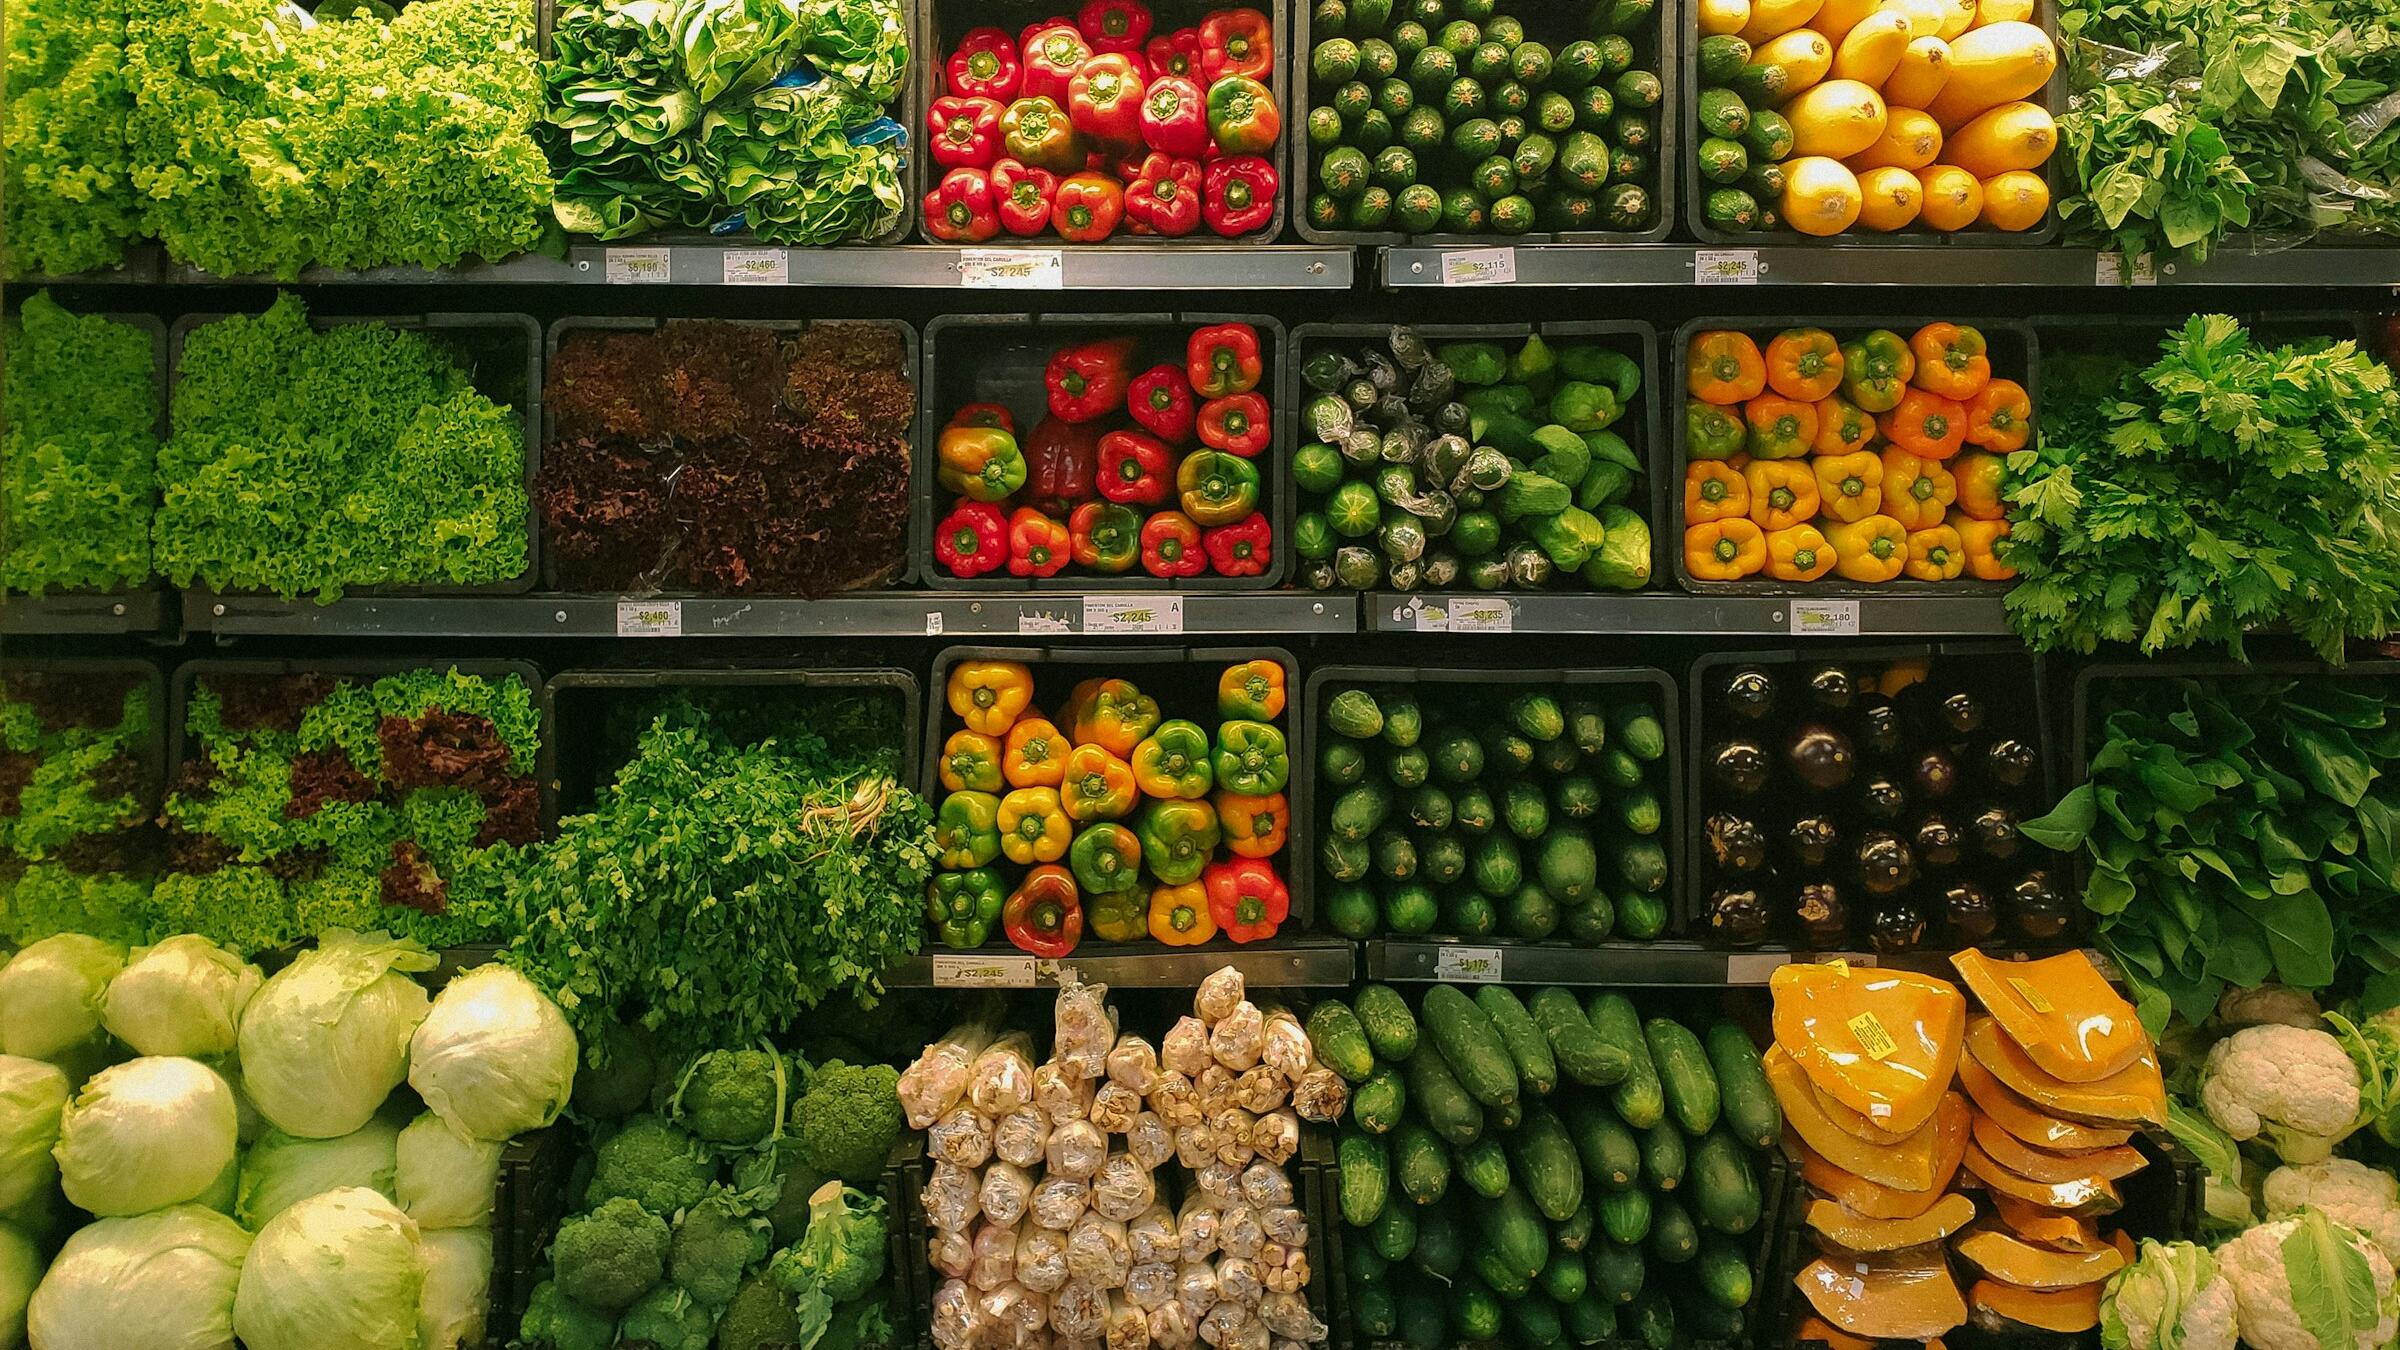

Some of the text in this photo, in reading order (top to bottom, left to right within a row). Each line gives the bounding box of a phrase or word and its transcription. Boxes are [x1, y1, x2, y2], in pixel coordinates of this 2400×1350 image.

[1051, 257, 1060, 267] A
[1718, 261, 1747, 271] $2,245
[674, 601, 679, 611] C
[1171, 602, 1179, 612] A
[639, 611, 669, 621] $2,460
[1113, 613, 1152, 624] $2,245
[1494, 951, 1500, 960] A
[1024, 962, 1032, 970] A
